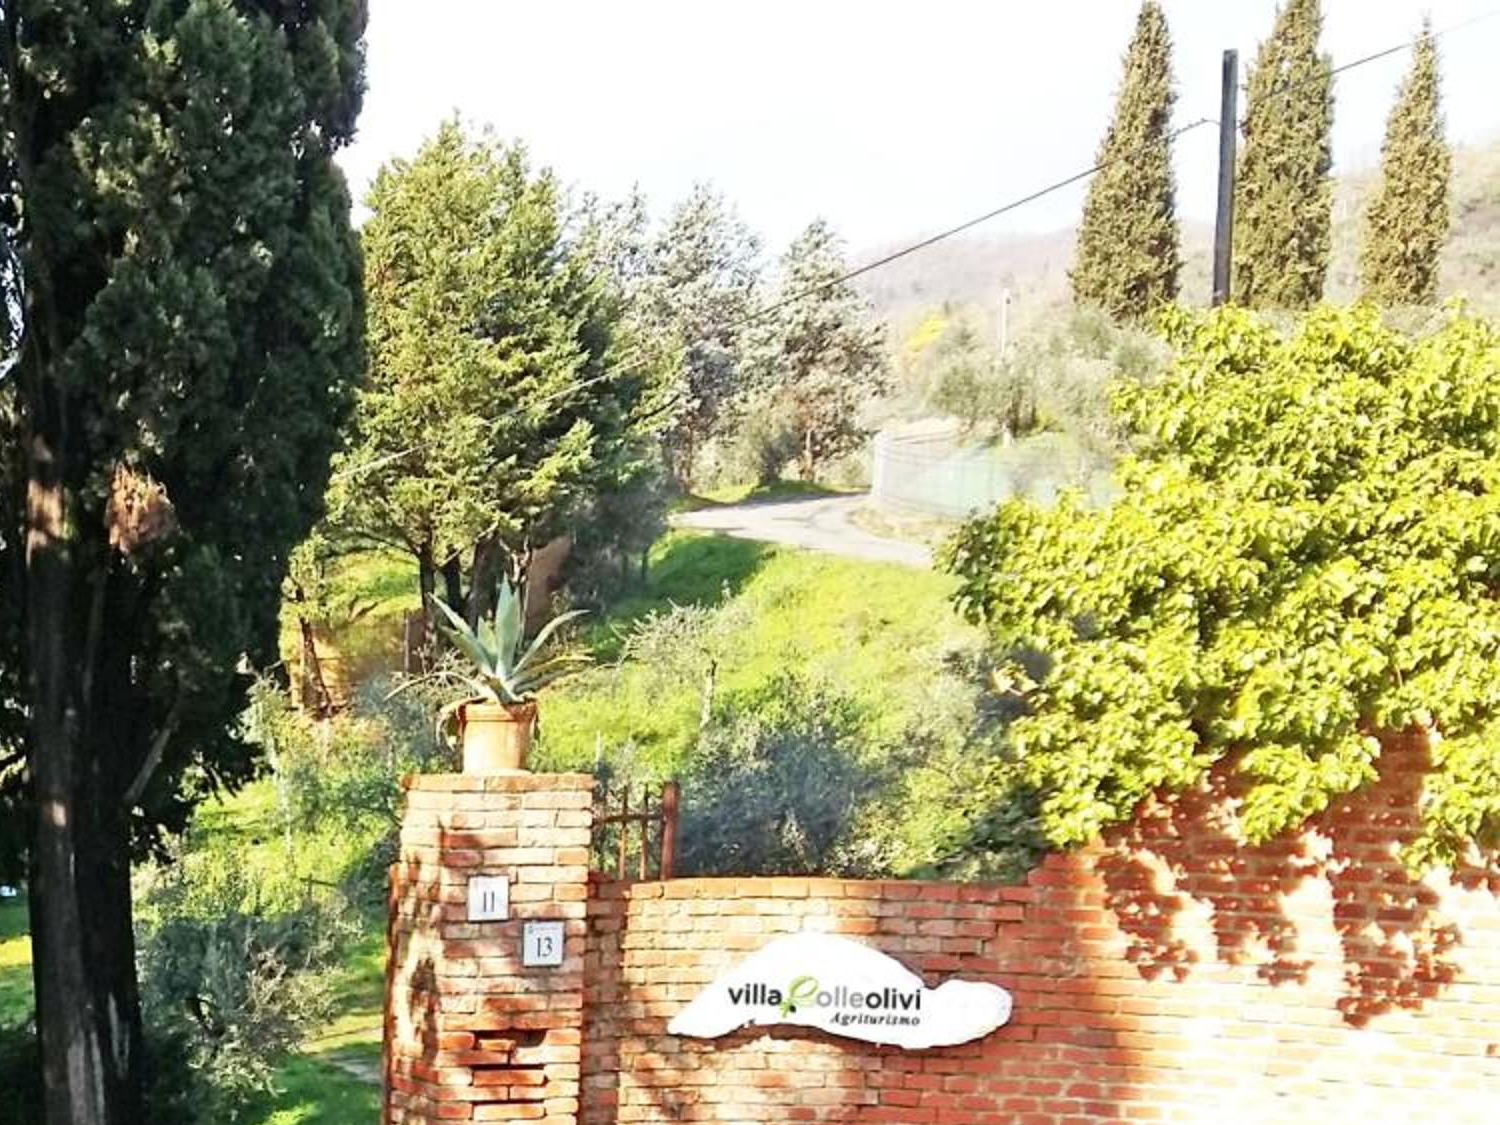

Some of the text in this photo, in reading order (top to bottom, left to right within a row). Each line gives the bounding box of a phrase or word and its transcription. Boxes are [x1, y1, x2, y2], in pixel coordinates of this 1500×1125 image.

[483, 891, 495, 913] 11
[536, 936, 554, 958] 13
[830, 1012, 921, 1027] Agriturismo
